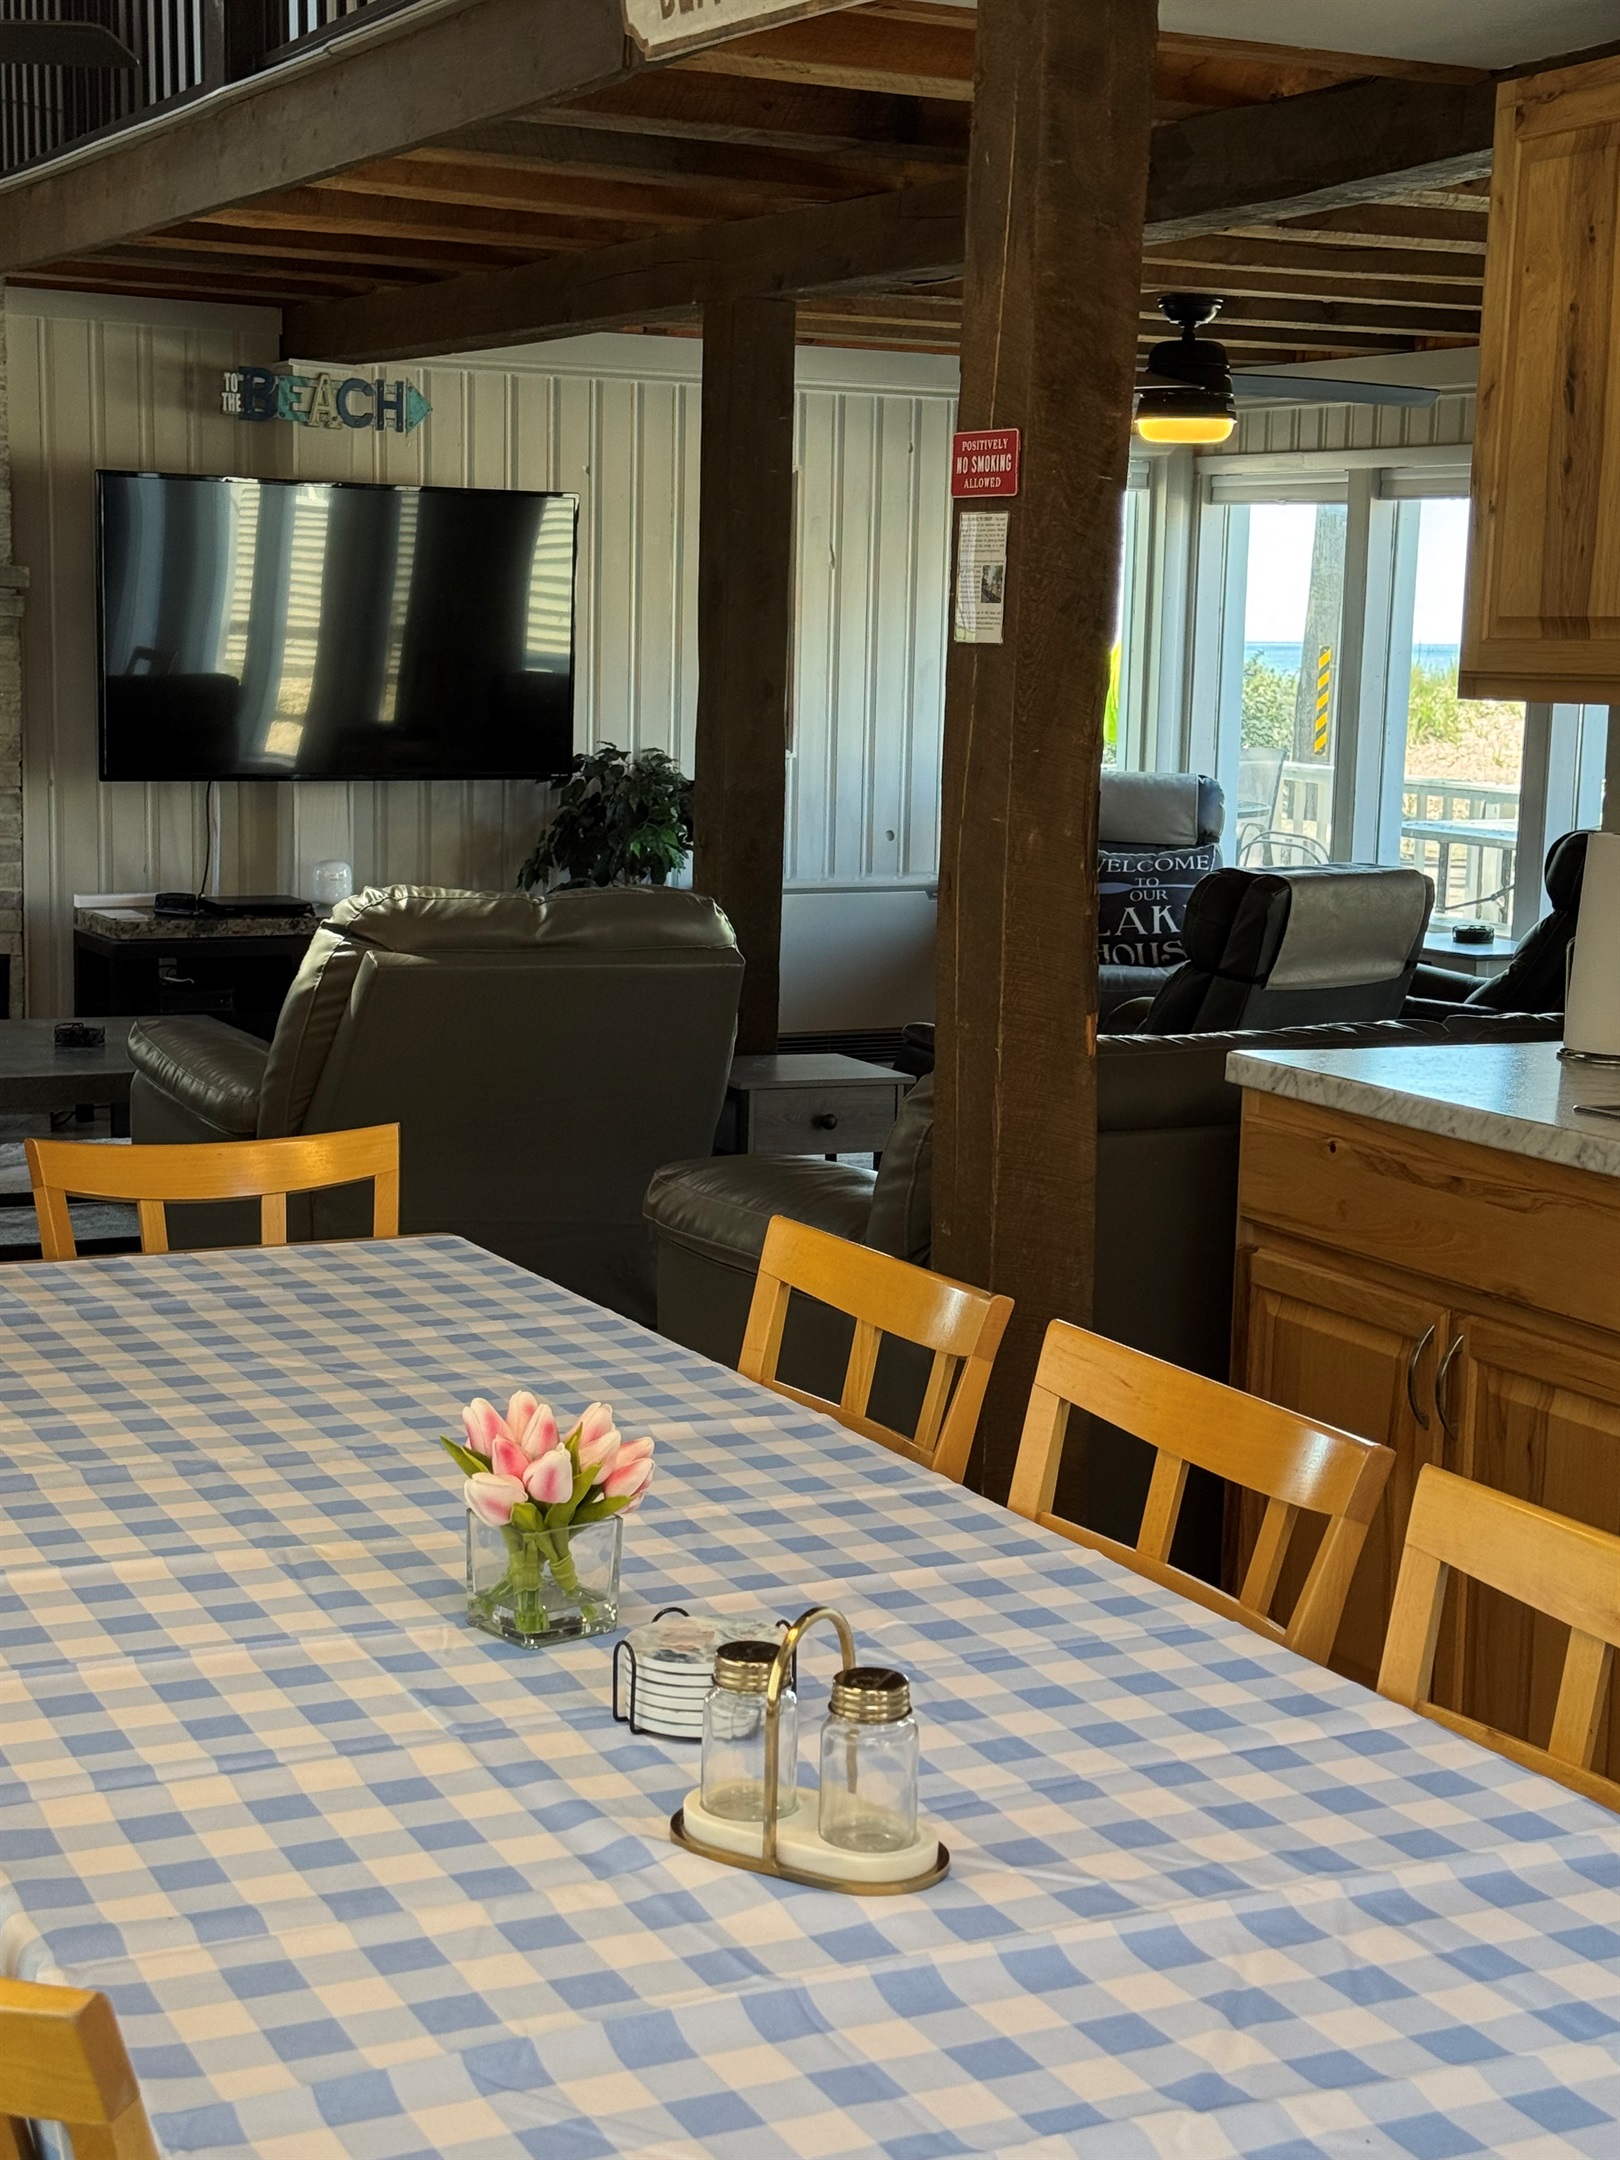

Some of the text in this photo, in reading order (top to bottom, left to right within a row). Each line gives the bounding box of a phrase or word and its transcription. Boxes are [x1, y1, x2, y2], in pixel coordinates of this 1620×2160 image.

[223, 372, 238, 393] TO
[221, 392, 242, 413] THE
[239, 366, 404, 433] BEACH
[962, 438, 1009, 452] POSITIVELY
[956, 453, 1012, 475] NO SMOKING
[963, 477, 1001, 489] ALLOWED
[1135, 877, 1160, 887] TO
[1129, 889, 1168, 902] OUR
[1098, 904, 1187, 936] AK
